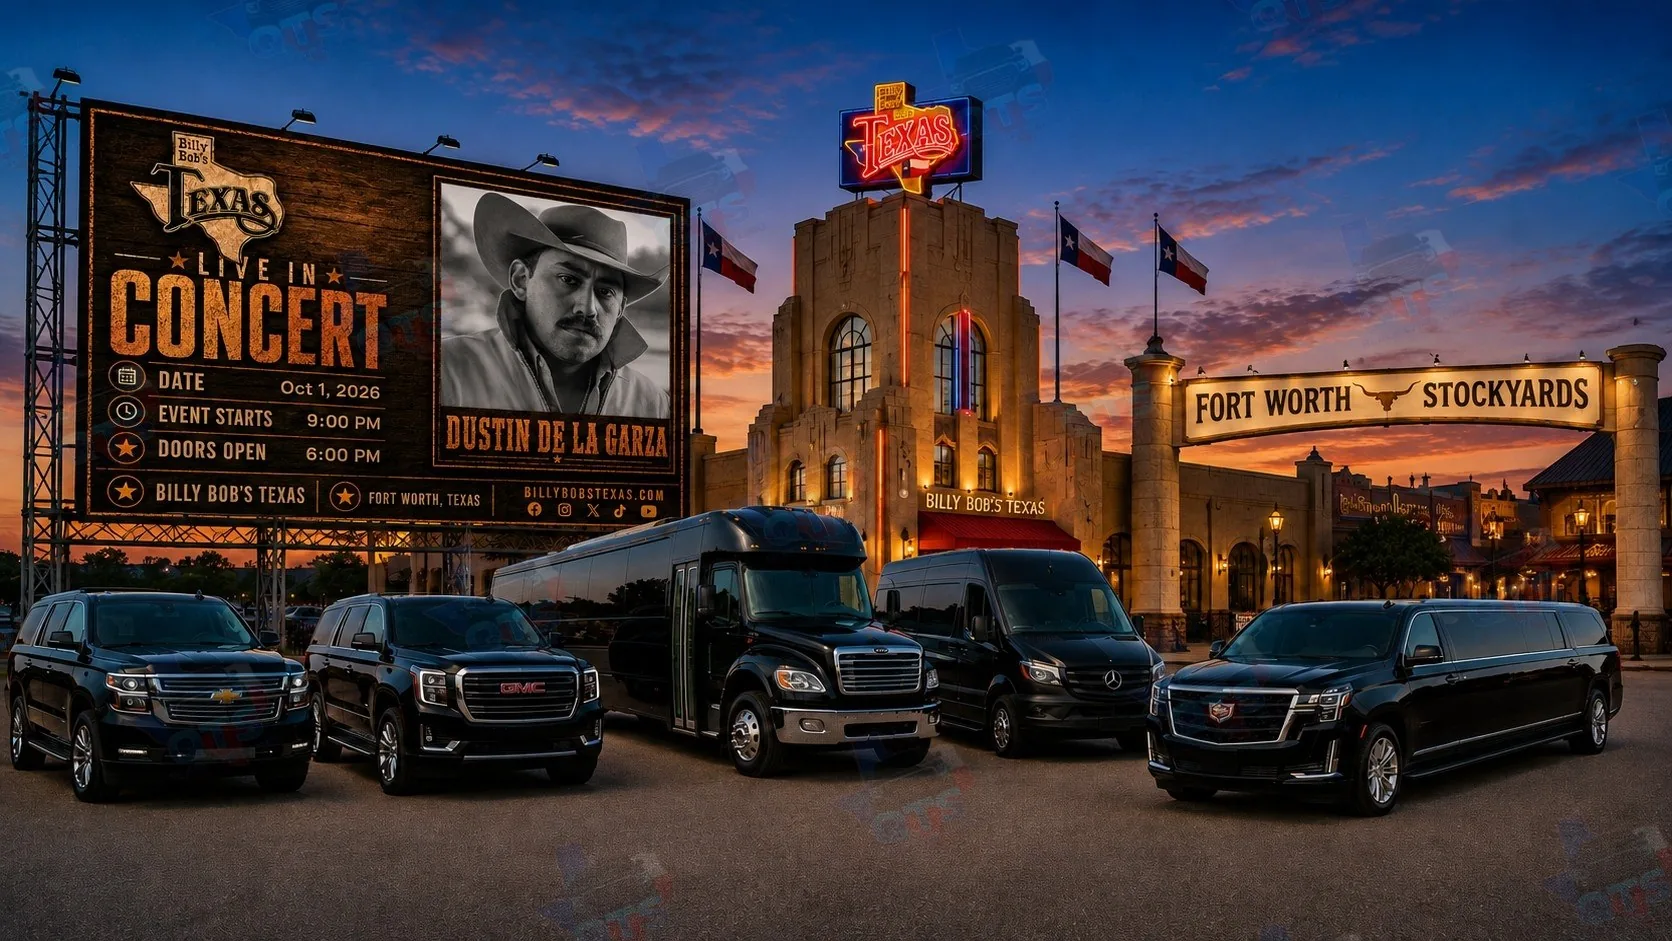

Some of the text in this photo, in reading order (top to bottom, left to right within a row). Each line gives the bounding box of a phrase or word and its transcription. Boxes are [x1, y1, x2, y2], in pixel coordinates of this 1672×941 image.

[178, 138, 208, 153] Billy
[853, 115, 953, 178] TEXAS
[178, 150, 209, 166] Bob's
[150, 163, 280, 238] TEXAS
[199, 252, 316, 285] LIVE IN
[110, 269, 387, 369] CONCERT
[159, 371, 380, 400] DATE Oct 1, 2026
[1195, 377, 1589, 424] FORT WORTH STOCKYARDS
[159, 405, 381, 430] EVENT STARTS 9:00 PM
[446, 415, 668, 458] DUSTIN DE LA GARZA
[158, 439, 381, 463] DOORS OPEN 6:00 PM
[156, 483, 306, 505] BILLY BOB'S TEXAS
[368, 491, 481, 507] FORT WORTH, TEXAS
[524, 485, 665, 502] BILLYBOBSTEXAS.COM
[926, 493, 1046, 515] BILLY BOB'S TEXAS
[500, 682, 546, 694] GMC
